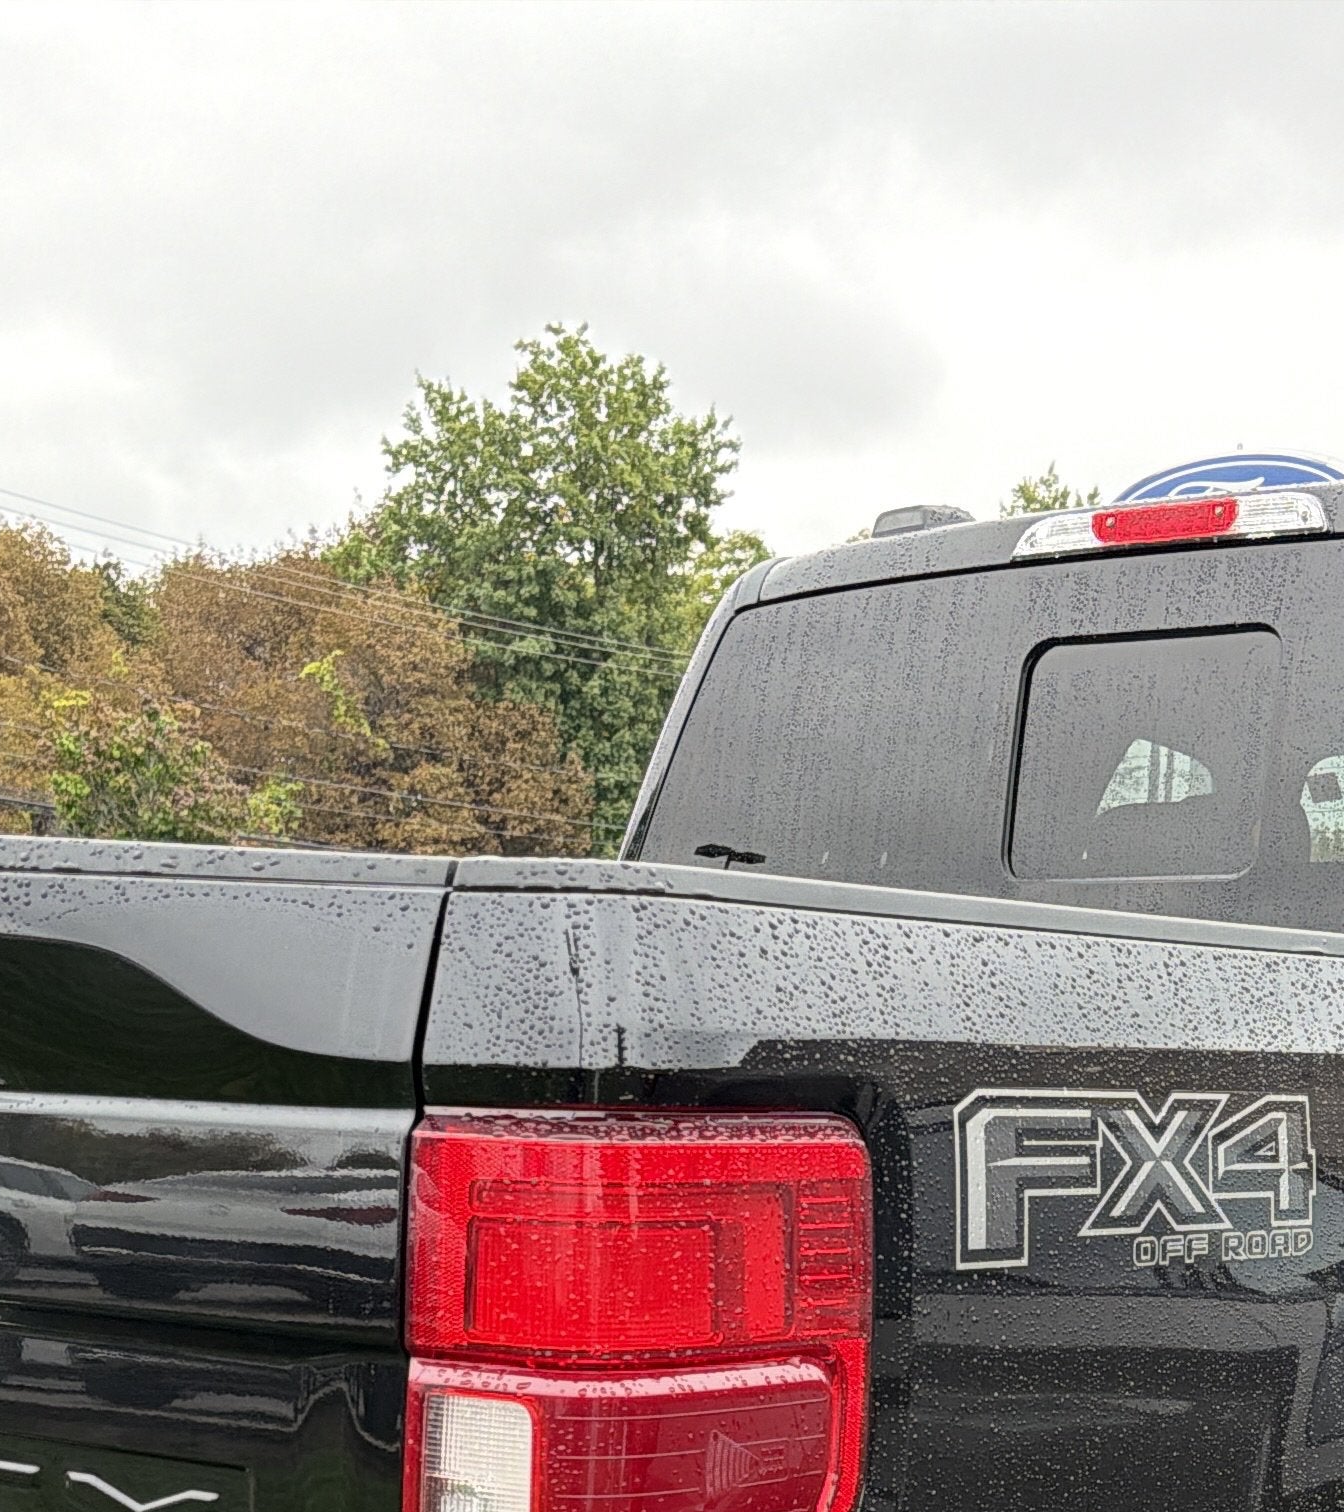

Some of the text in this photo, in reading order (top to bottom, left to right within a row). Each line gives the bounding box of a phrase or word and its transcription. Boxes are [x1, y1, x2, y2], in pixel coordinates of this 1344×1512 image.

[953, 1088, 1317, 1271] FX4
[1133, 1228, 1313, 1267] OFF ROAD
